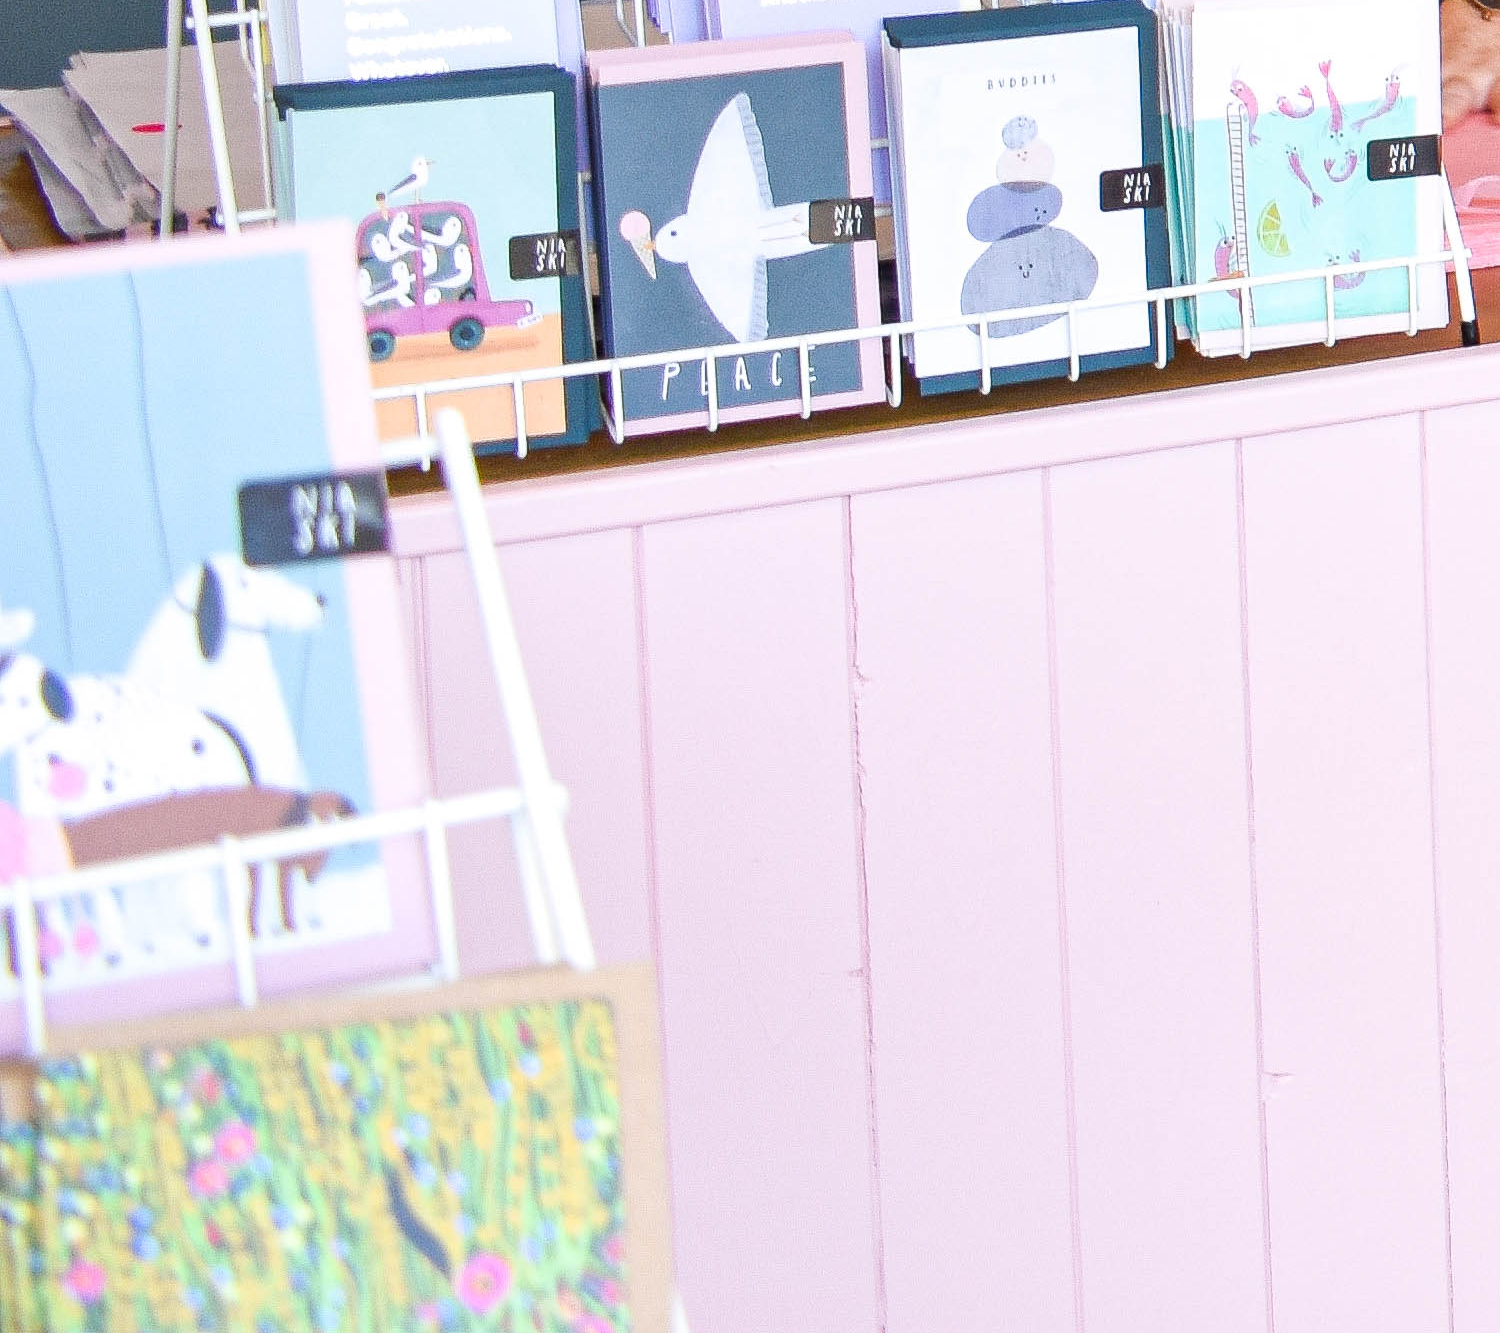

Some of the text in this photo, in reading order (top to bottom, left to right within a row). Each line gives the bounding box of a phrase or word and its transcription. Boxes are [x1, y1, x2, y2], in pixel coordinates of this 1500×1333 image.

[1389, 143, 1416, 158] NIA
[1388, 155, 1415, 173] SKI
[1123, 171, 1152, 188] NIA
[1122, 185, 1151, 204] SKI
[834, 204, 863, 221] NIA
[834, 219, 862, 237] SKI
[536, 237, 567, 255] NIA
[535, 251, 566, 272] SKI
[289, 480, 357, 518] NIA
[292, 512, 357, 558] SKI
